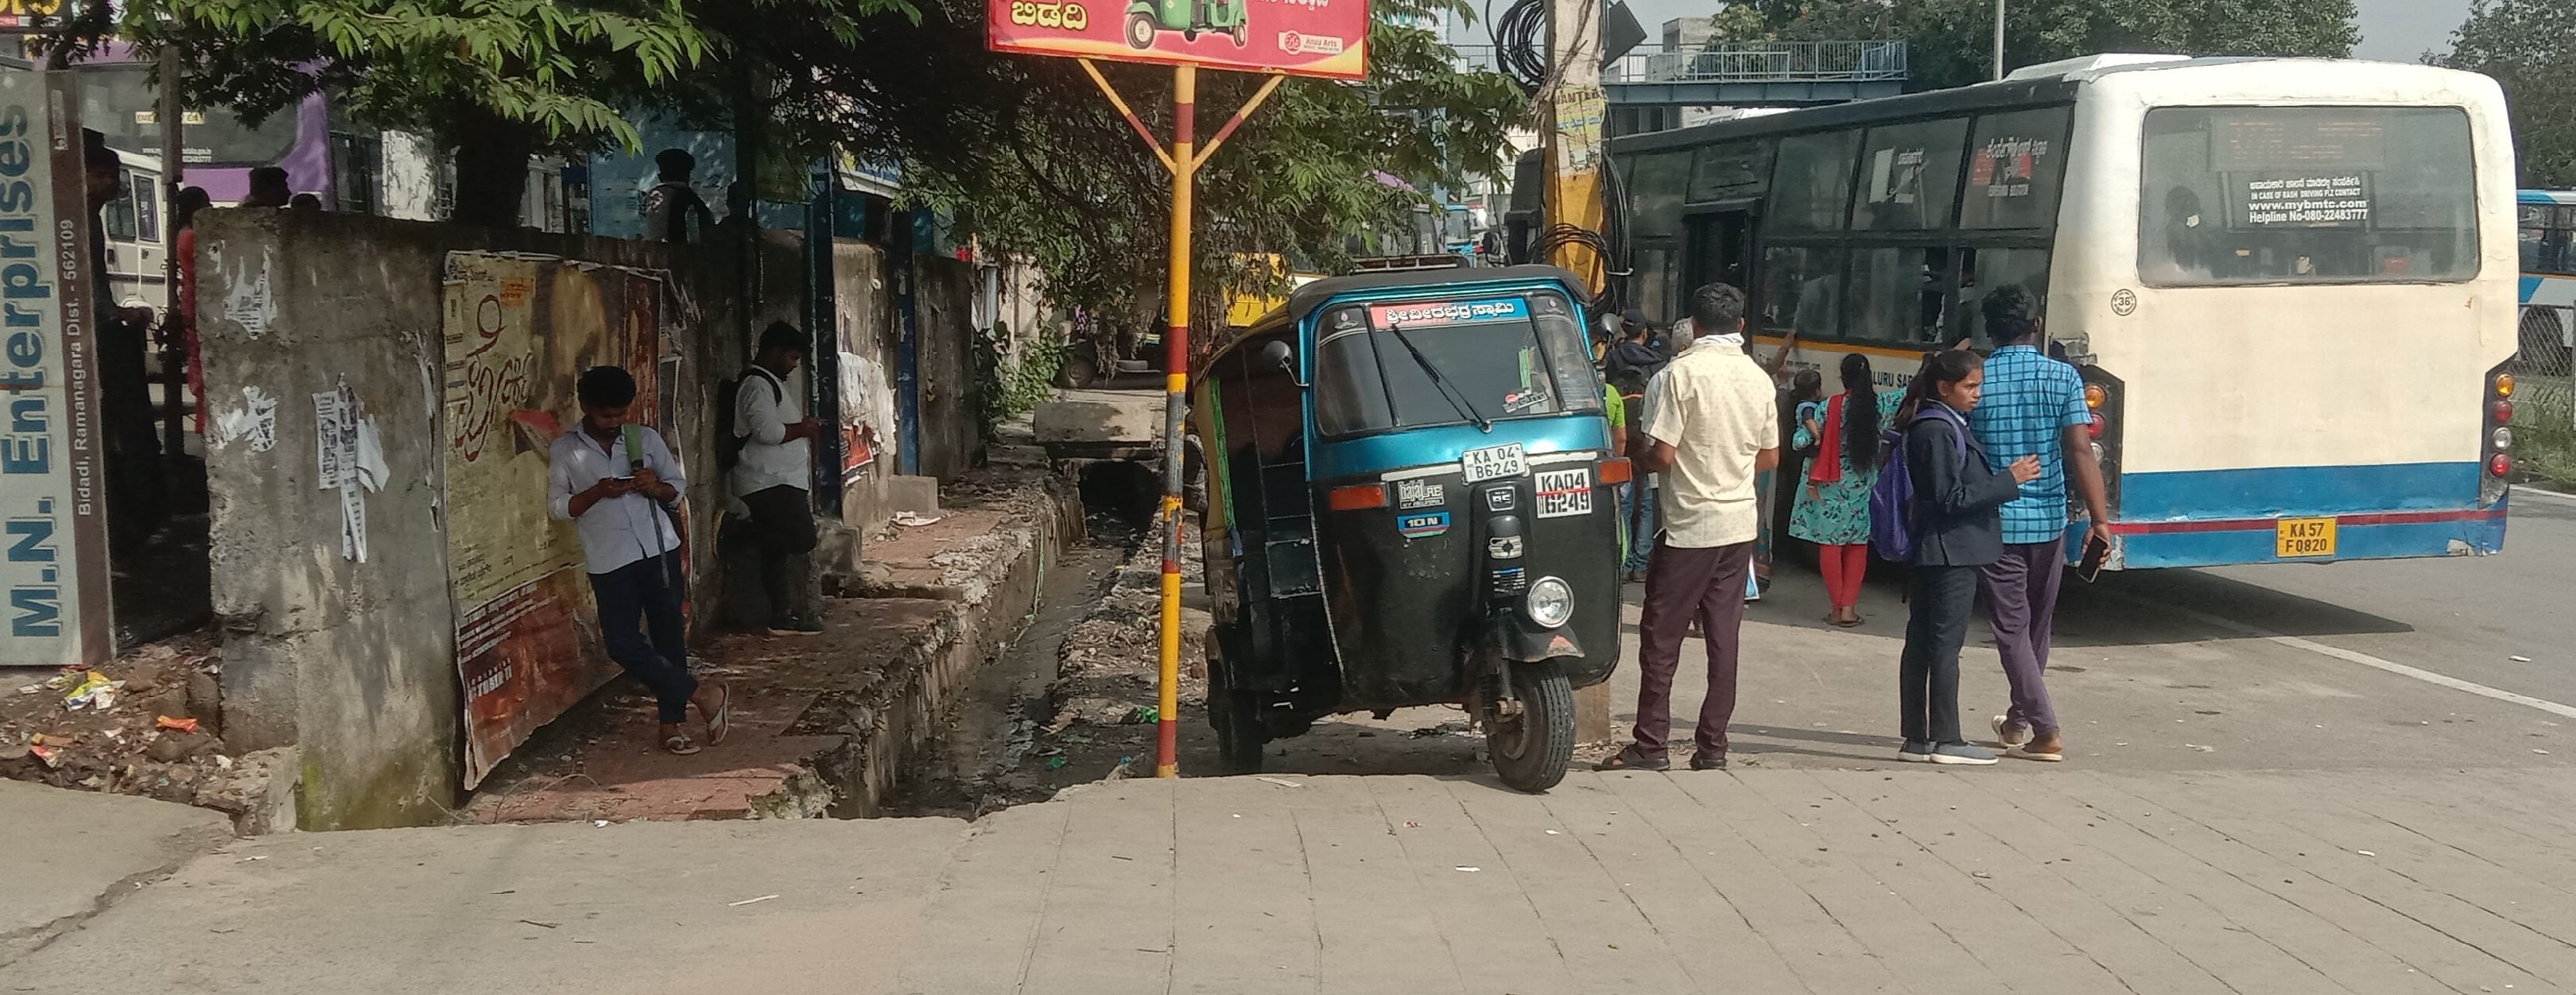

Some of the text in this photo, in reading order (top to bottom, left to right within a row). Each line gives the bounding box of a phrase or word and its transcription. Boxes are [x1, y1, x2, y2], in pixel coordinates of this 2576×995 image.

[1011, 0, 1088, 30] ಬಿಡದಿ
[2259, 191, 2274, 199] CASE
[2283, 190, 2298, 199] RASH
[2300, 189, 2323, 198] DRIVING
[2334, 188, 2361, 197] CONTACT
[2248, 199, 2368, 211] www.mybmtc.com
[2249, 209, 2368, 225] Helpline No-080-22483777
[60, 219, 77, 280] 562109
[0, 104, 51, 474] Enterprises
[2118, 297, 2131, 306] 36
[64, 296, 80, 335] Dist.
[1872, 372, 1894, 387] LURU
[70, 342, 88, 451] Ramanagara
[1472, 447, 1515, 465] KA 04
[1476, 459, 1519, 478] B6249
[76, 455, 91, 516] Bidadi,
[1541, 472, 1585, 492] KA04
[2290, 522, 2325, 537] KA 57
